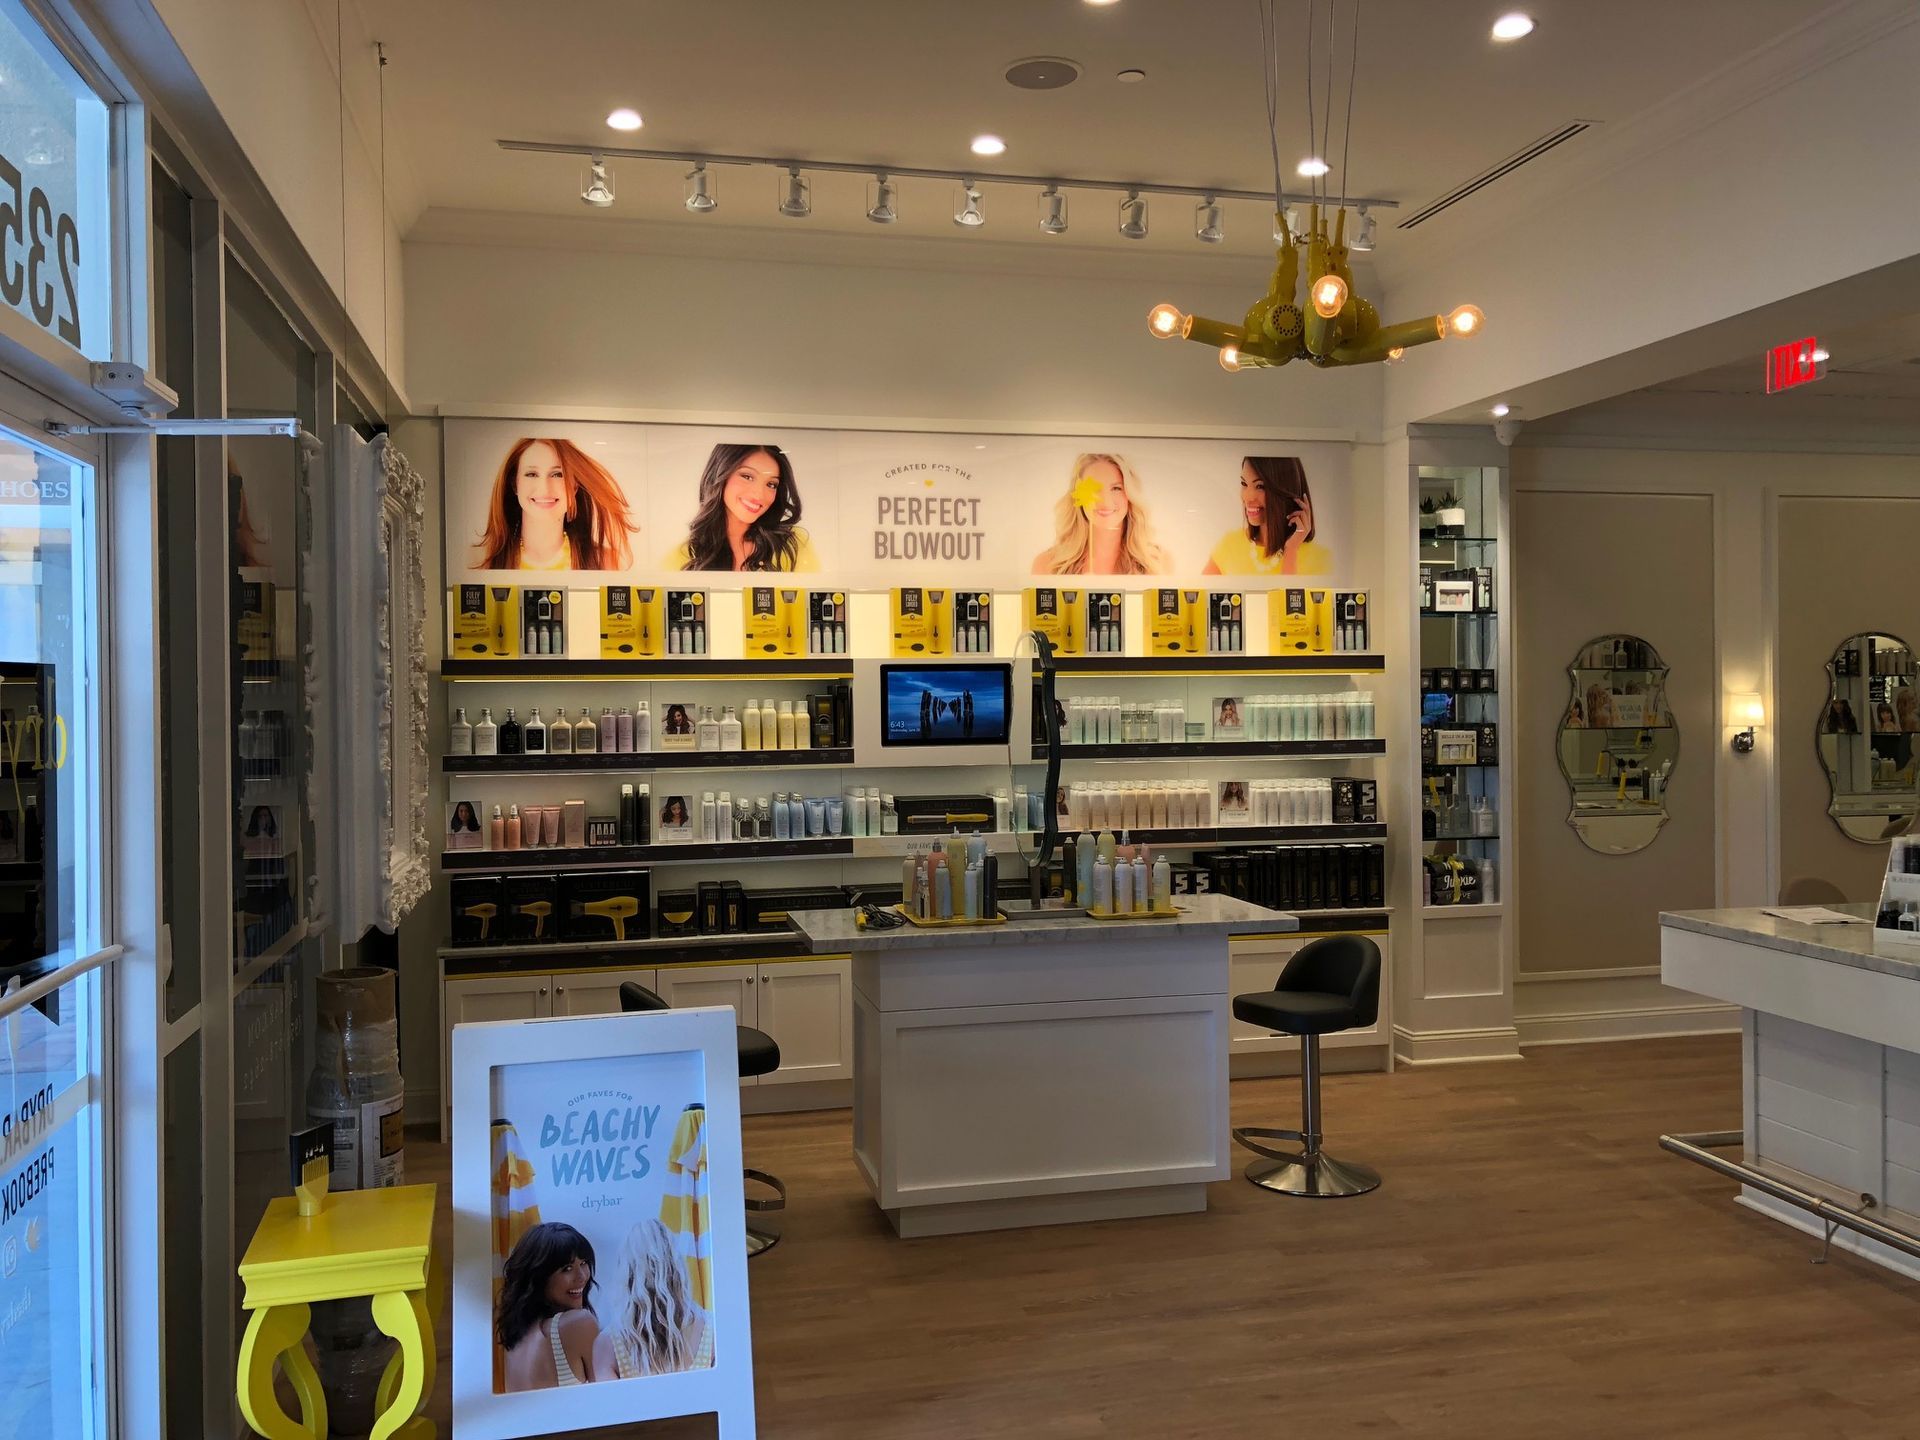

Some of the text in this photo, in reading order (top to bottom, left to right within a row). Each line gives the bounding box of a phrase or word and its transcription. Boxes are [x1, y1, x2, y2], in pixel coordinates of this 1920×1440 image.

[885, 463, 972, 480] CREATED FOR THE
[878, 496, 981, 526] PERFECT
[874, 531, 985, 561] BLOWOUT
[568, 1090, 633, 1107] OUR FAVES FOR
[540, 1104, 661, 1148] BEACHY
[552, 1144, 650, 1187] WAVES
[581, 1195, 624, 1212] drybar
